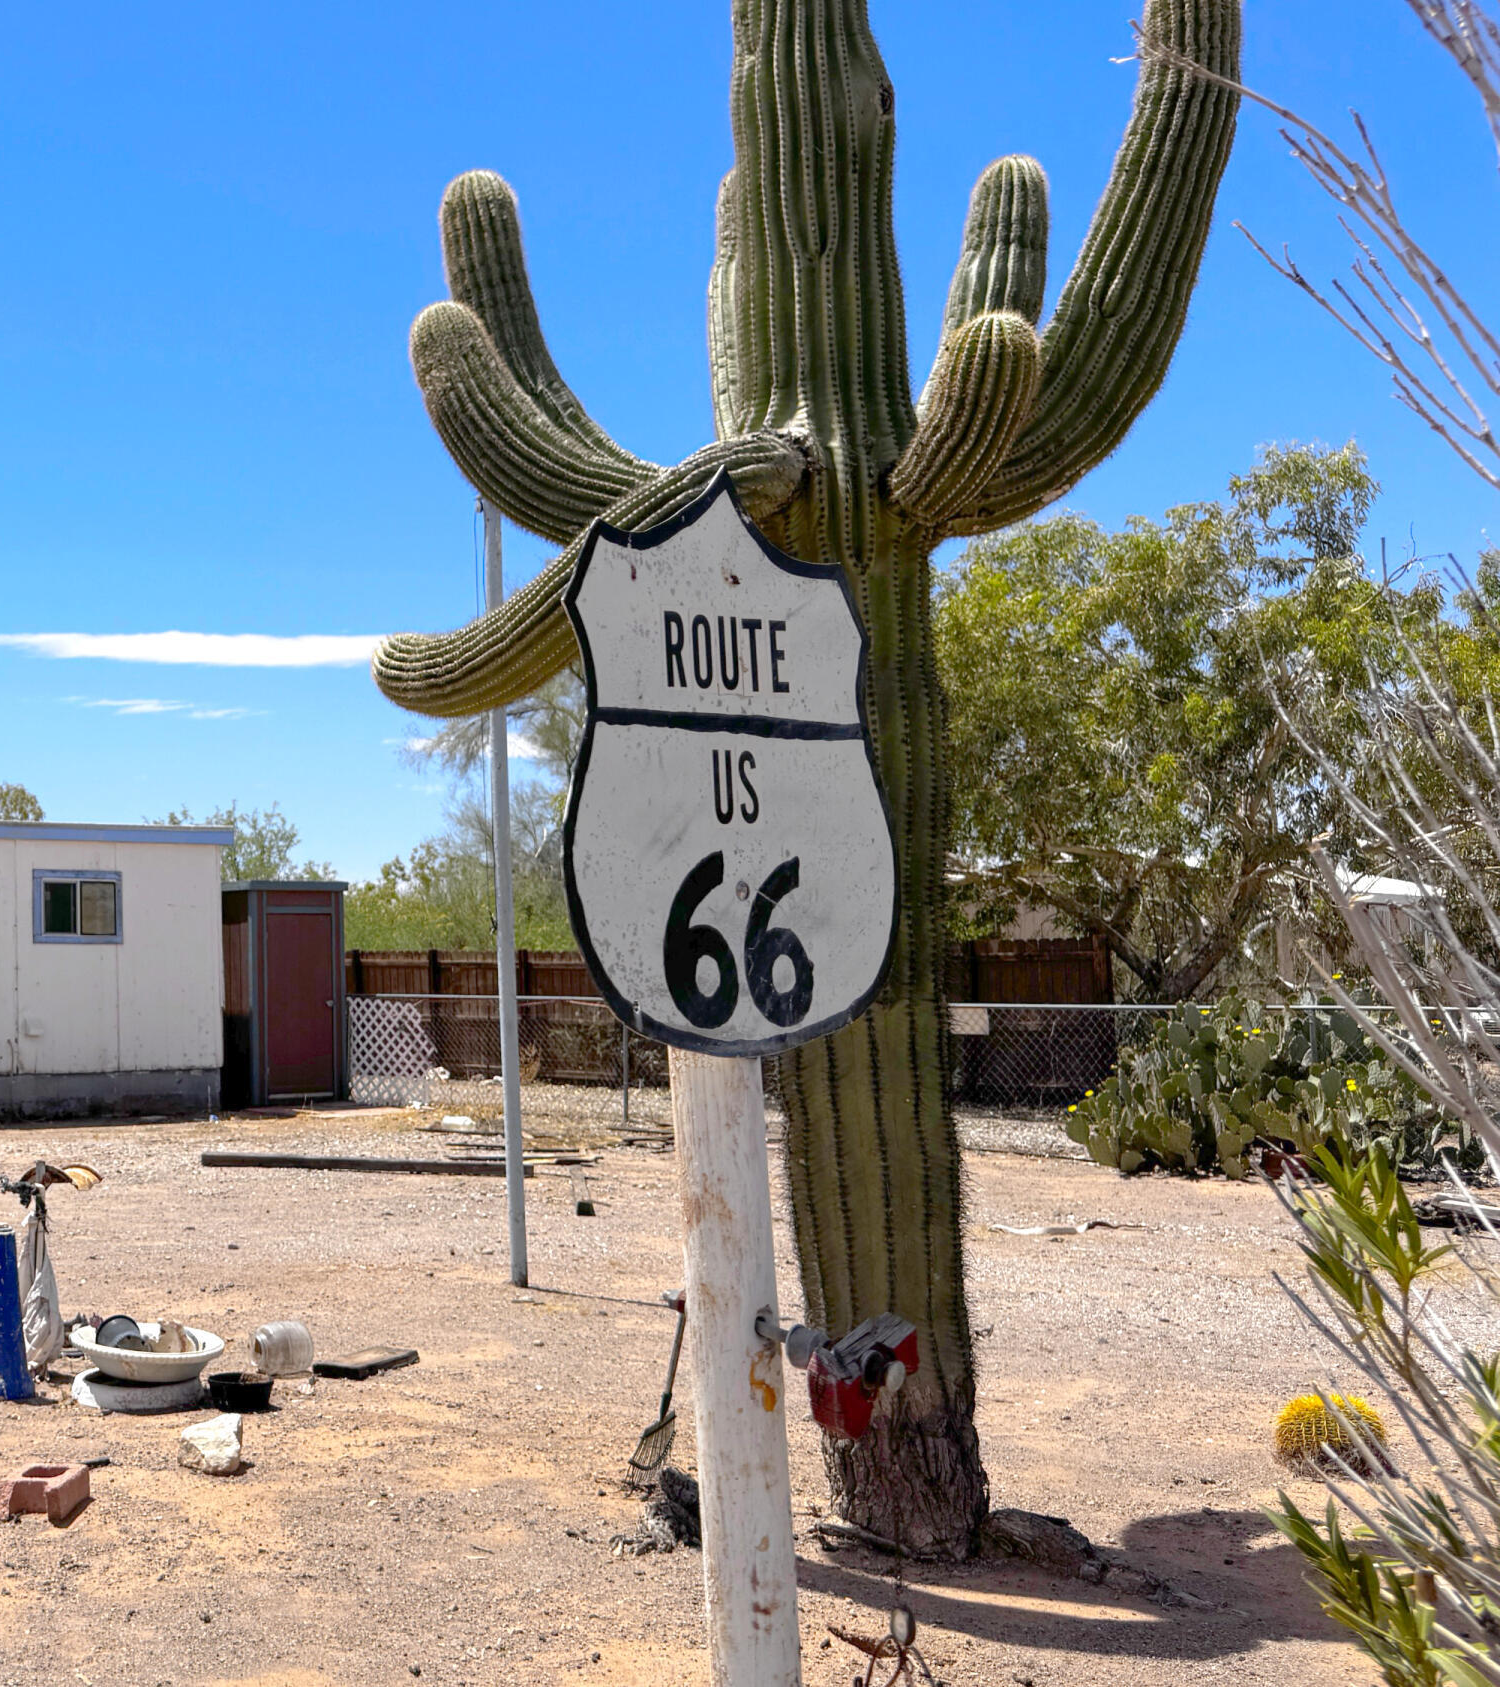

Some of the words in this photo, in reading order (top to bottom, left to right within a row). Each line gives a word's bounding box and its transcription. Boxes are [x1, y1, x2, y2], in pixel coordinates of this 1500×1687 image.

[663, 610, 790, 694] ROUTE
[711, 749, 760, 824] US
[663, 850, 814, 1029] 66
